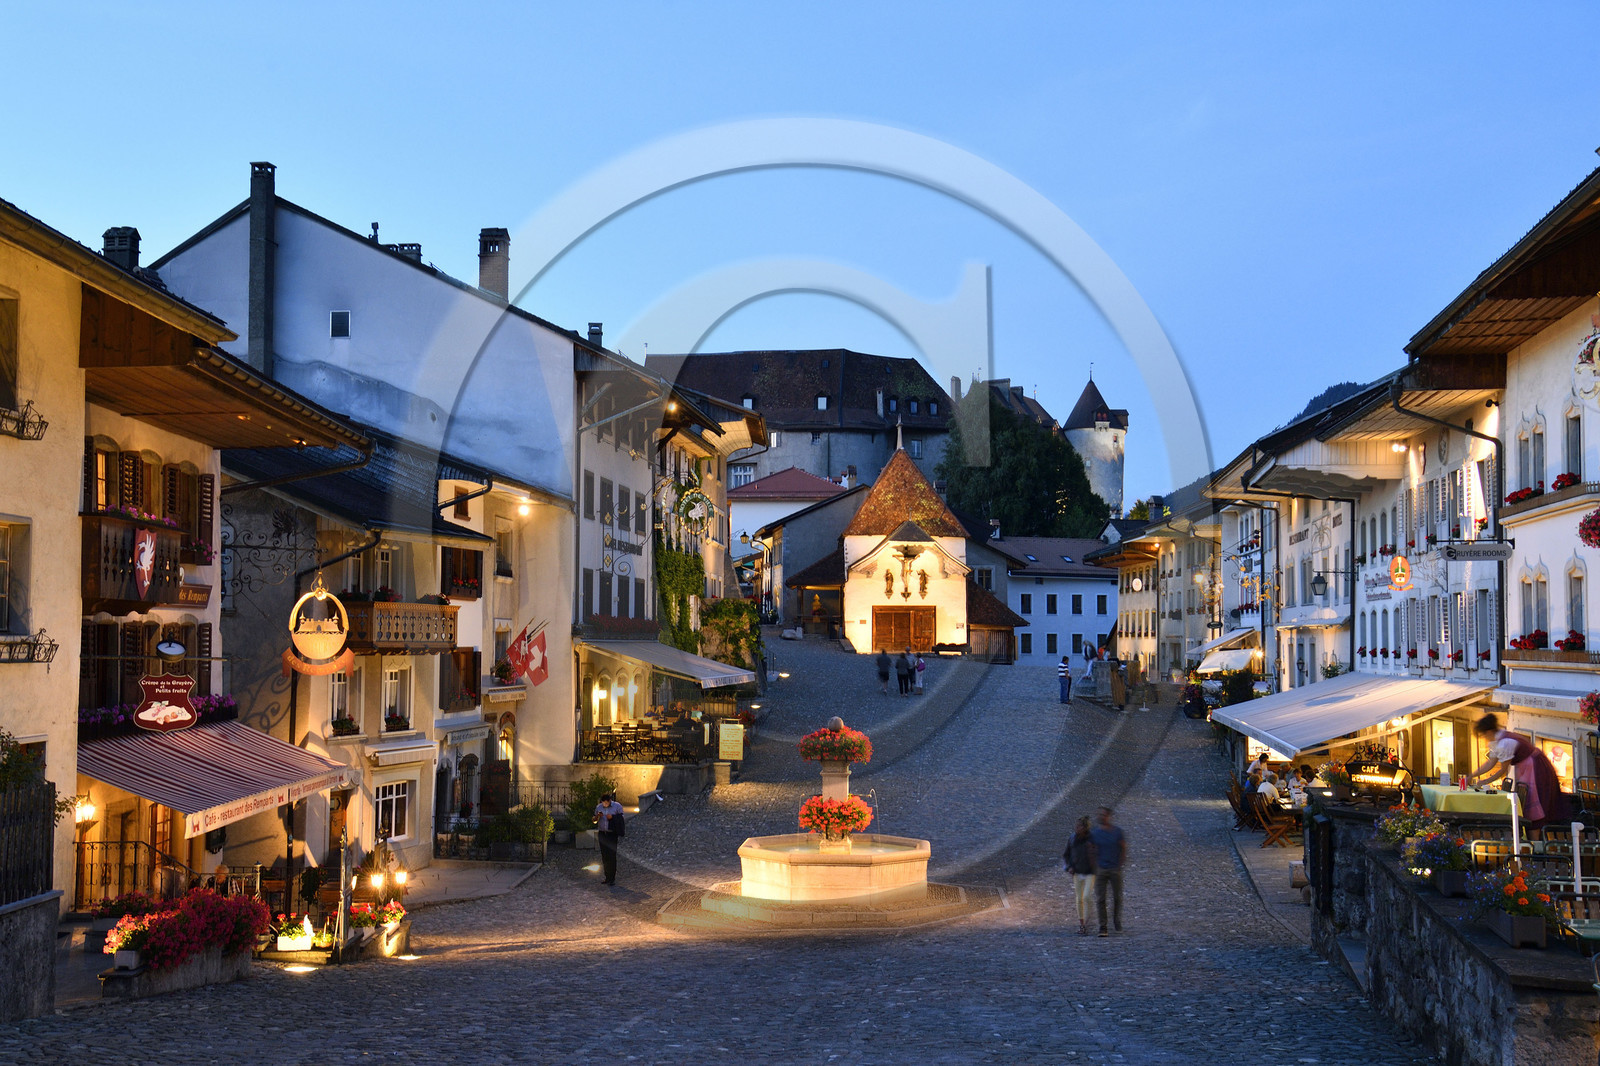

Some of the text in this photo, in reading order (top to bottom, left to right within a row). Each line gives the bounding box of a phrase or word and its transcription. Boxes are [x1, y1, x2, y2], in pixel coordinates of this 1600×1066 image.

[1361, 763, 1380, 774] CAFÉ
[204, 811, 217, 828] Café
[220, 805, 245, 821] restaurant
[244, 801, 253, 813] des
[253, 796, 274, 809] Remparts
